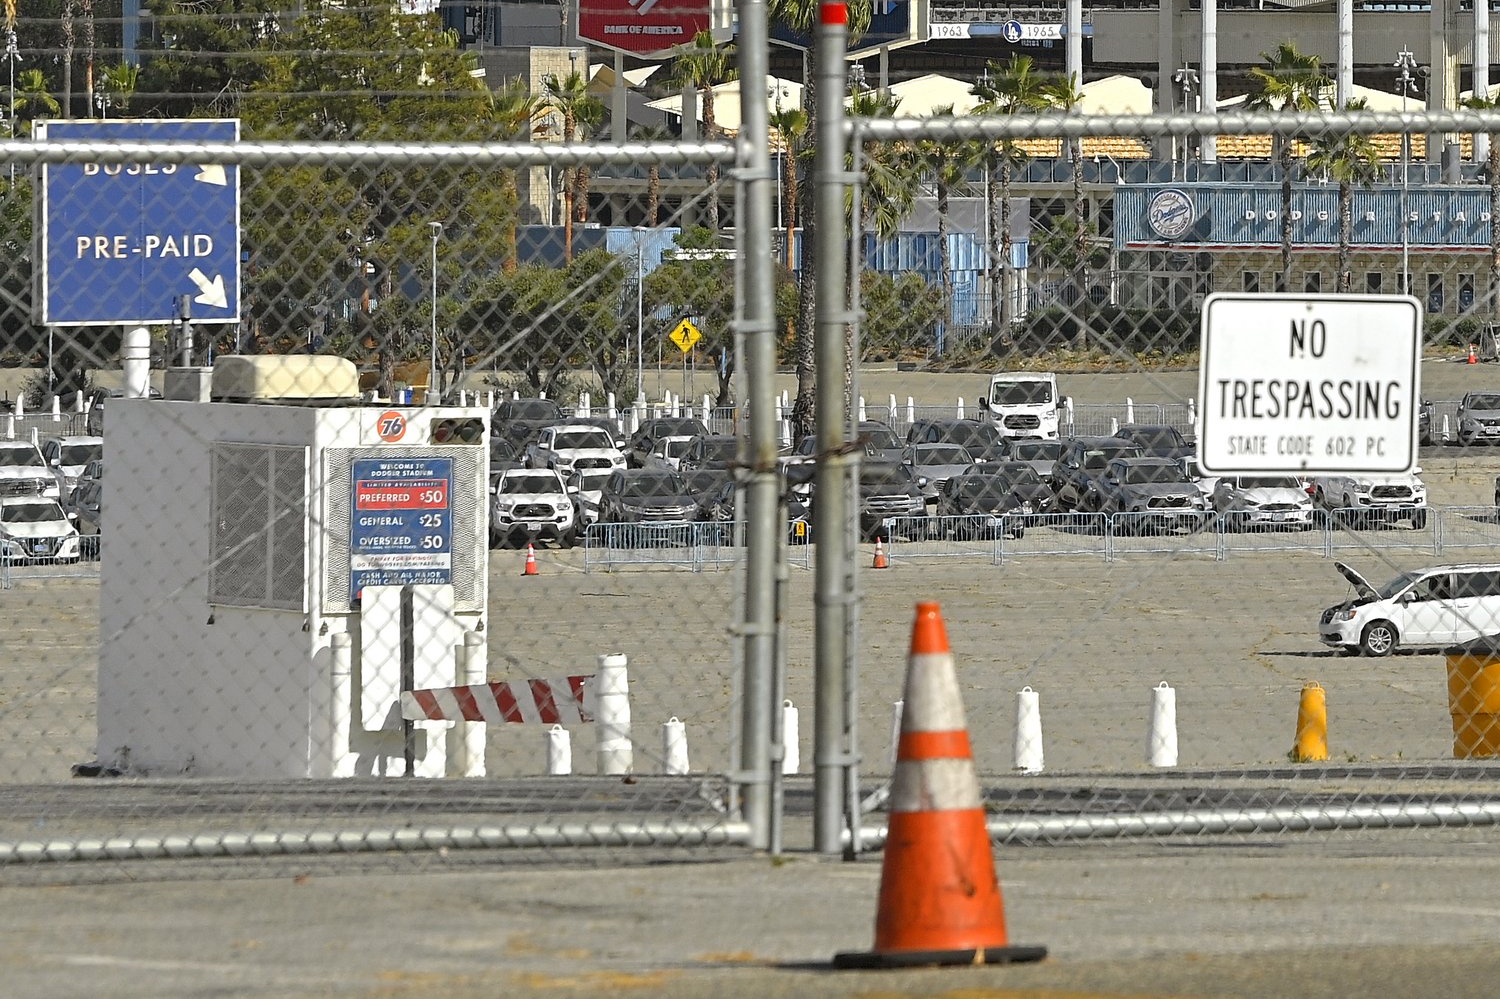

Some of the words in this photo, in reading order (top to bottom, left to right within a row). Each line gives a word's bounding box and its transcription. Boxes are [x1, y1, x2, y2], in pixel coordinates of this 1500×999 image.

[604, 25, 629, 34] BANK
[938, 25, 961, 36] 1963
[1027, 26, 1054, 37] 1965
[1245, 210, 1375, 221] DODGR
[77, 234, 214, 259] PRE-PAID
[1289, 319, 1326, 359] NO
[1218, 380, 1400, 420] TRESPASSING
[381, 416, 402, 437] 76
[1227, 436, 1268, 456] STATE
[1277, 436, 1314, 456] CODE
[1325, 437, 1356, 457] 602
[1366, 437, 1386, 457] PC
[360, 493, 411, 503] PREFERRED
[420, 490, 443, 503] $50
[360, 516, 404, 526] GENERAL
[419, 513, 442, 527] $25
[359, 536, 411, 546] OVERSIZED
